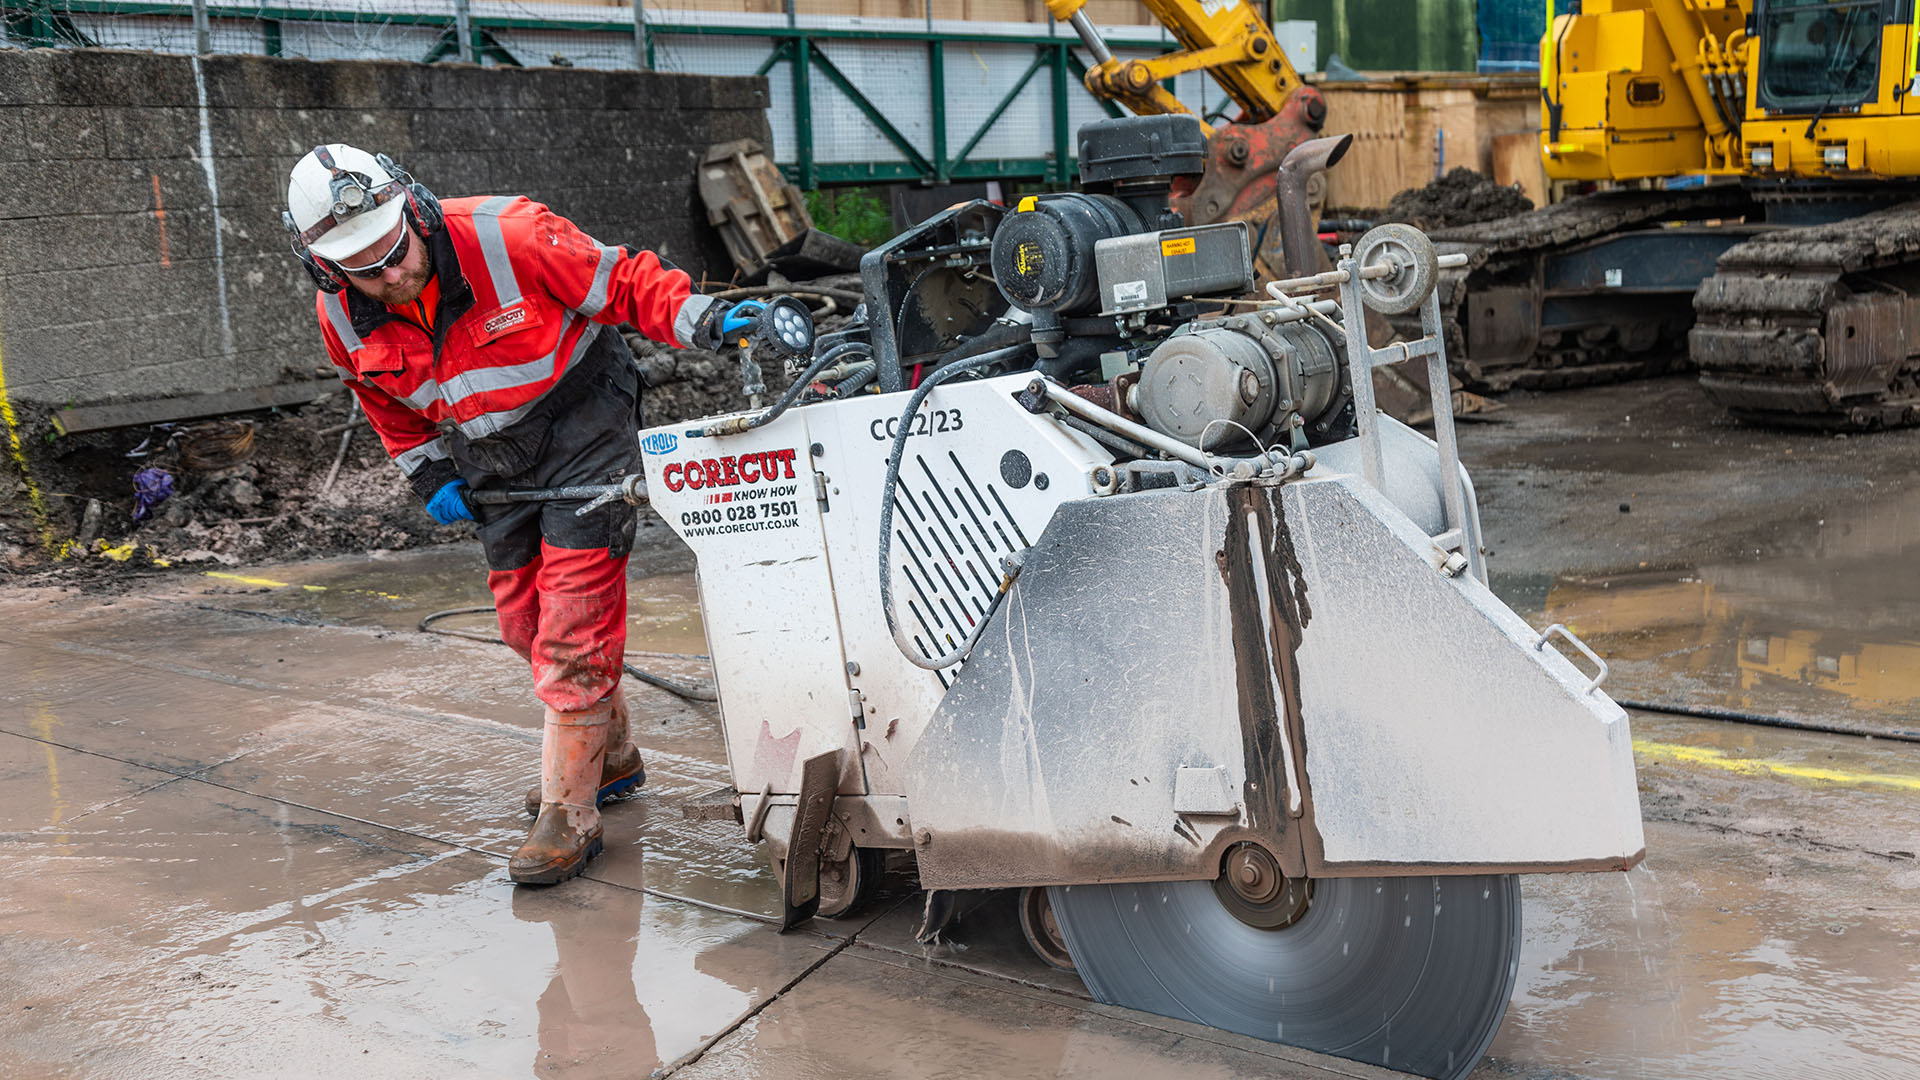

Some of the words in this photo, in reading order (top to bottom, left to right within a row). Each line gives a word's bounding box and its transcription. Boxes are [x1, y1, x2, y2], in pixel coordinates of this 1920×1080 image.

[485, 308, 524, 331] CORECUT
[641, 432, 679, 456] TYROLIT
[663, 448, 797, 493] CORECUT
[733, 488, 768, 502] KNOW
[770, 485, 797, 498] HOW
[681, 508, 722, 526] 0800
[726, 505, 757, 521] 028
[760, 500, 798, 518] 7501
[683, 518, 799, 538] WWW.CORECUT.CO.UK
